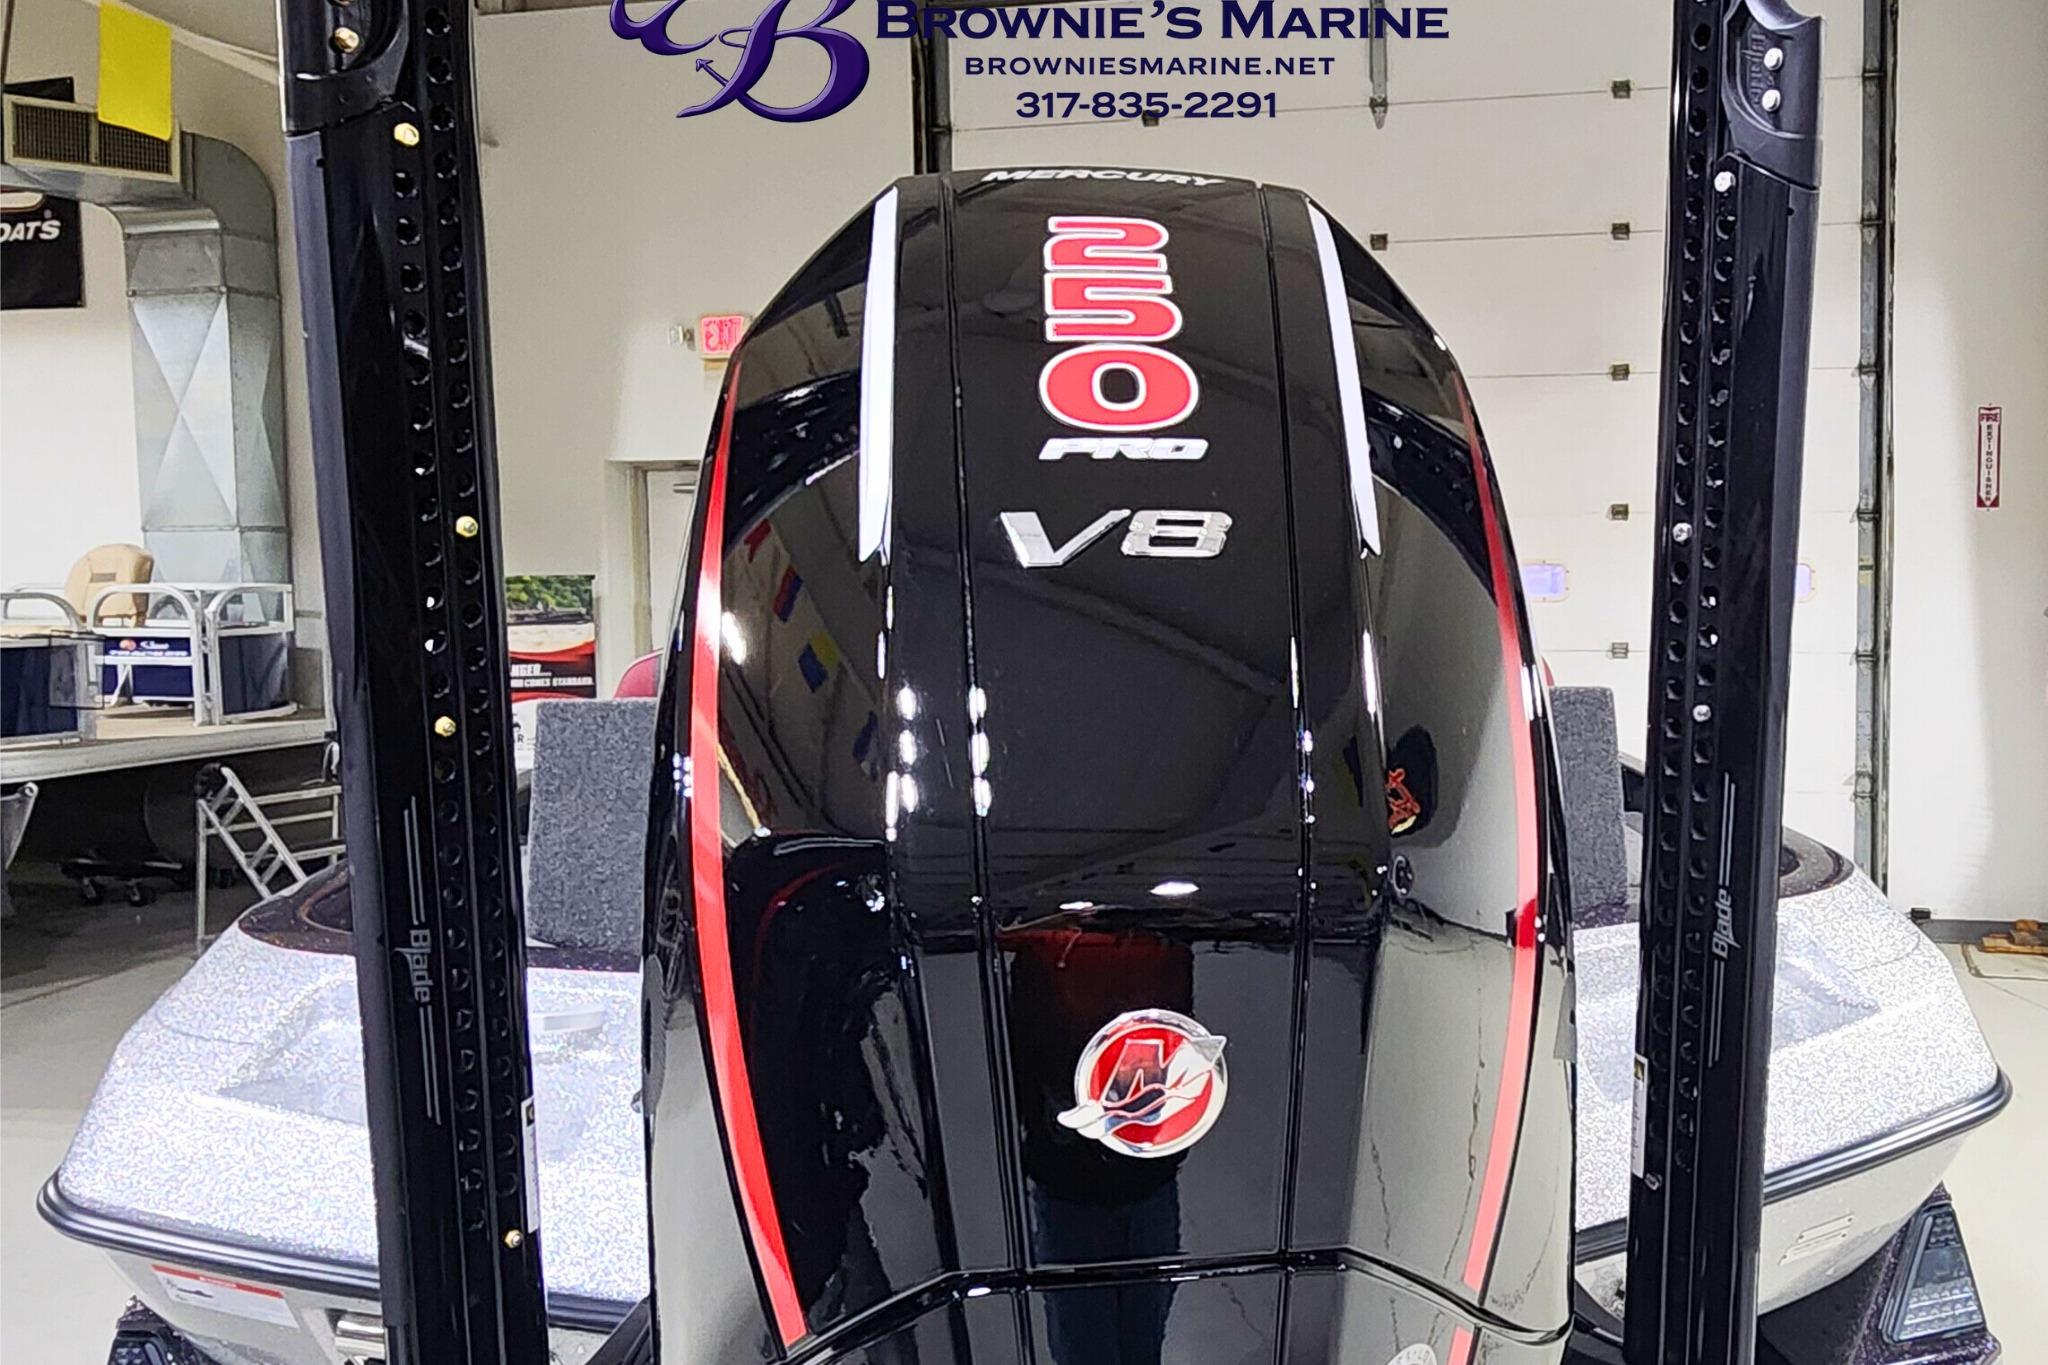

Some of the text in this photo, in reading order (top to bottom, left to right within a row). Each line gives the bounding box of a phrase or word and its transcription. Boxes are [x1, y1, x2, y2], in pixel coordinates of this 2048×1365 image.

[981, 169, 1225, 186] MERCURY
[1039, 216, 1200, 432] 250
[1980, 413, 1999, 422] FIRE
[1038, 438, 1209, 460] PRO
[1000, 508, 1233, 568] V8
[1712, 888, 1741, 959] Blade
[395, 929, 433, 1003] Blade
